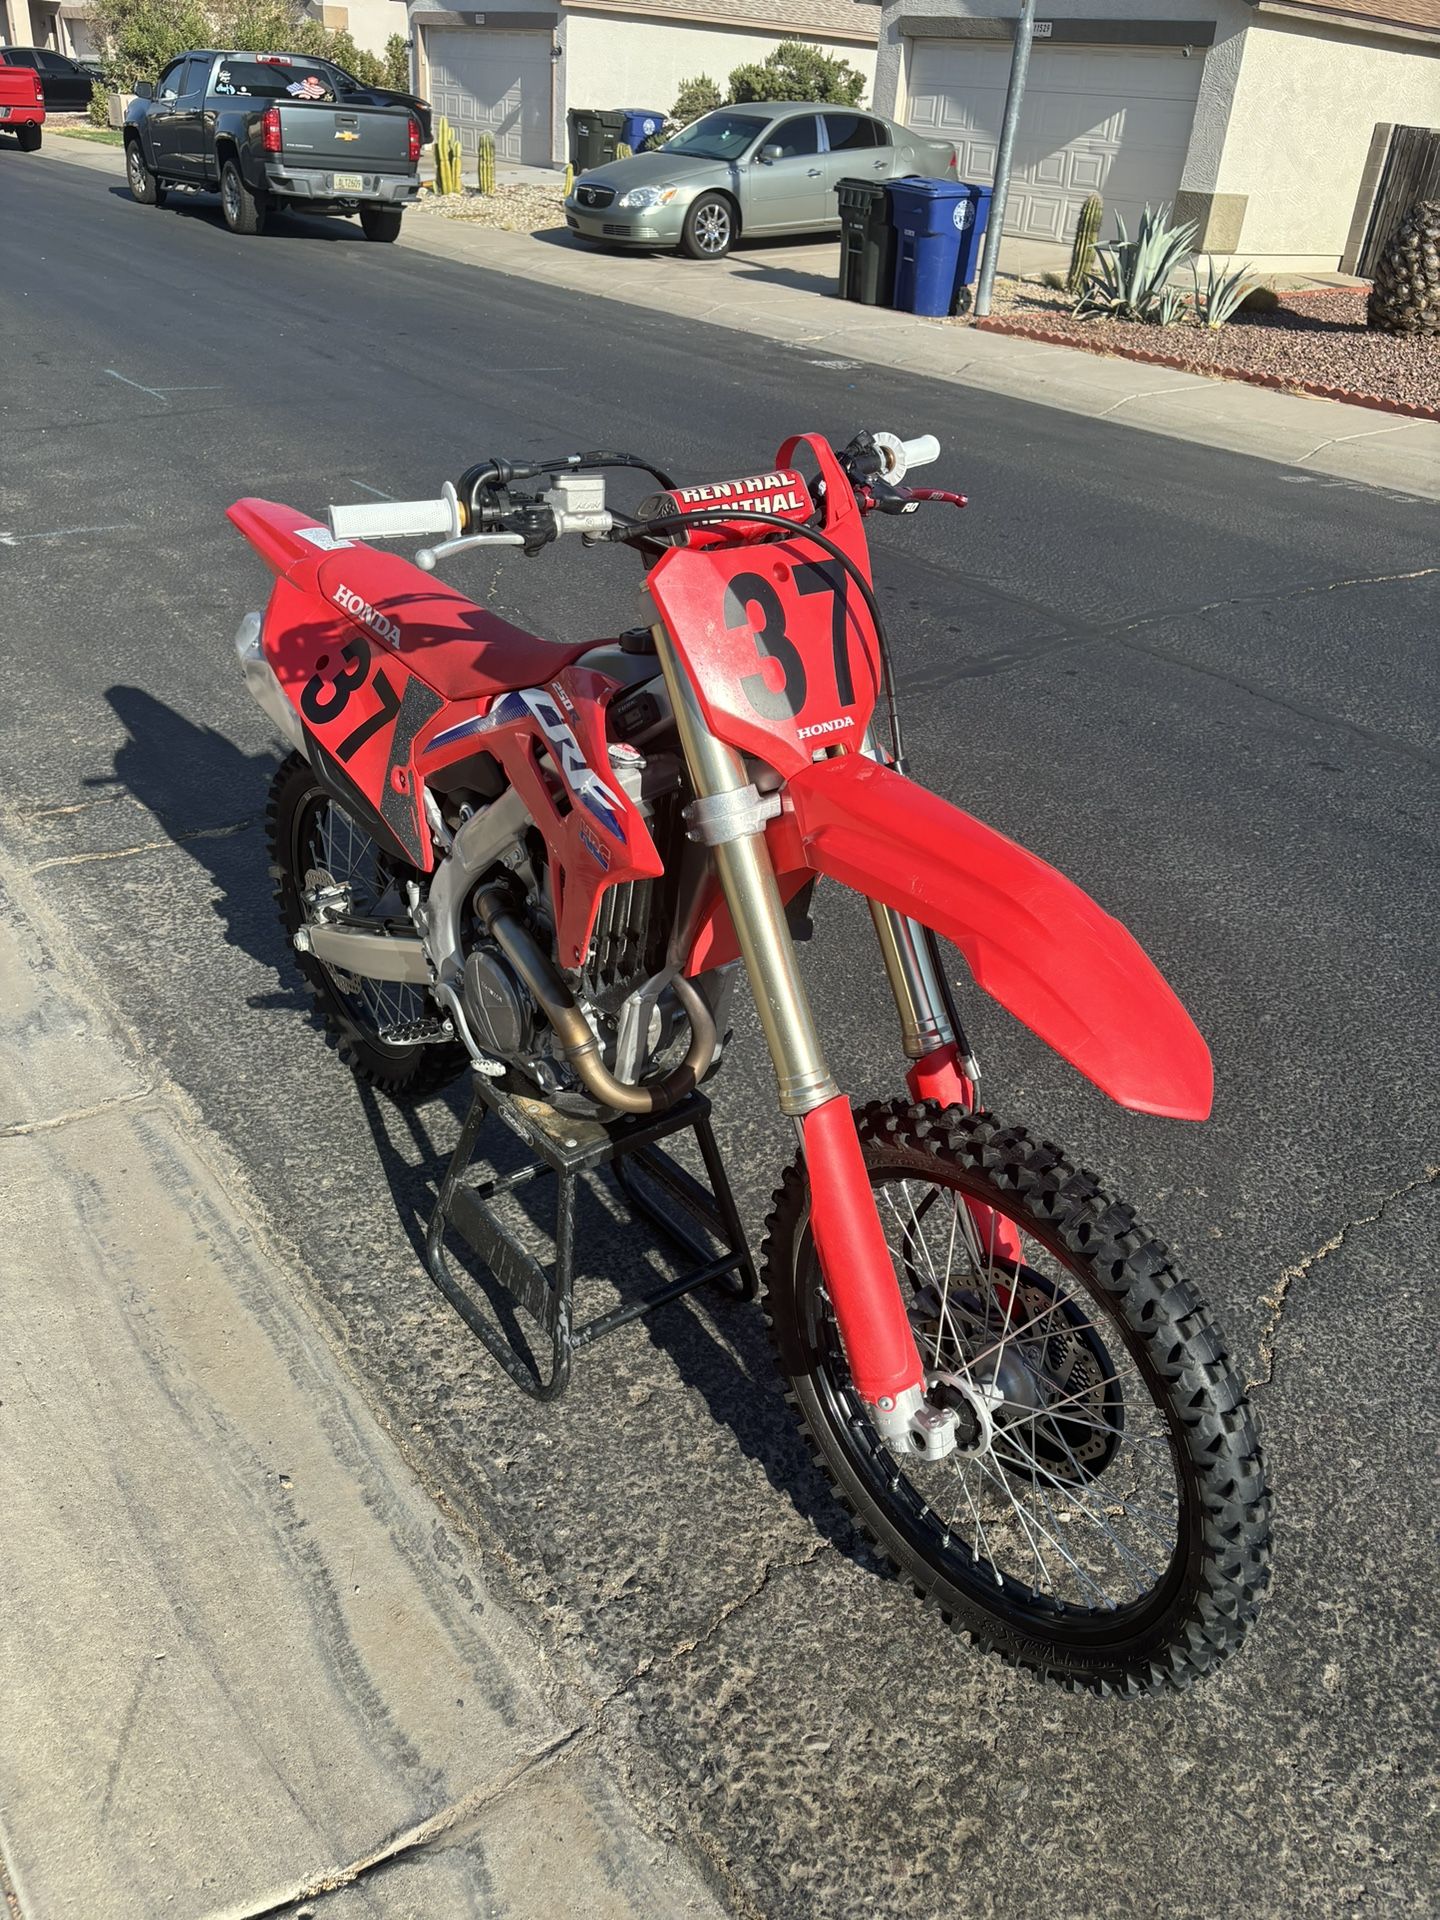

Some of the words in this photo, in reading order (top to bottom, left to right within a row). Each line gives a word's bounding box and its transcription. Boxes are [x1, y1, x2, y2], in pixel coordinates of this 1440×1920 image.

[680, 473, 796, 503] RENTHAL
[332, 583, 401, 650] HONDA
[723, 558, 857, 722] 37
[300, 636, 402, 764] 37
[797, 716, 855, 741] HONDA
